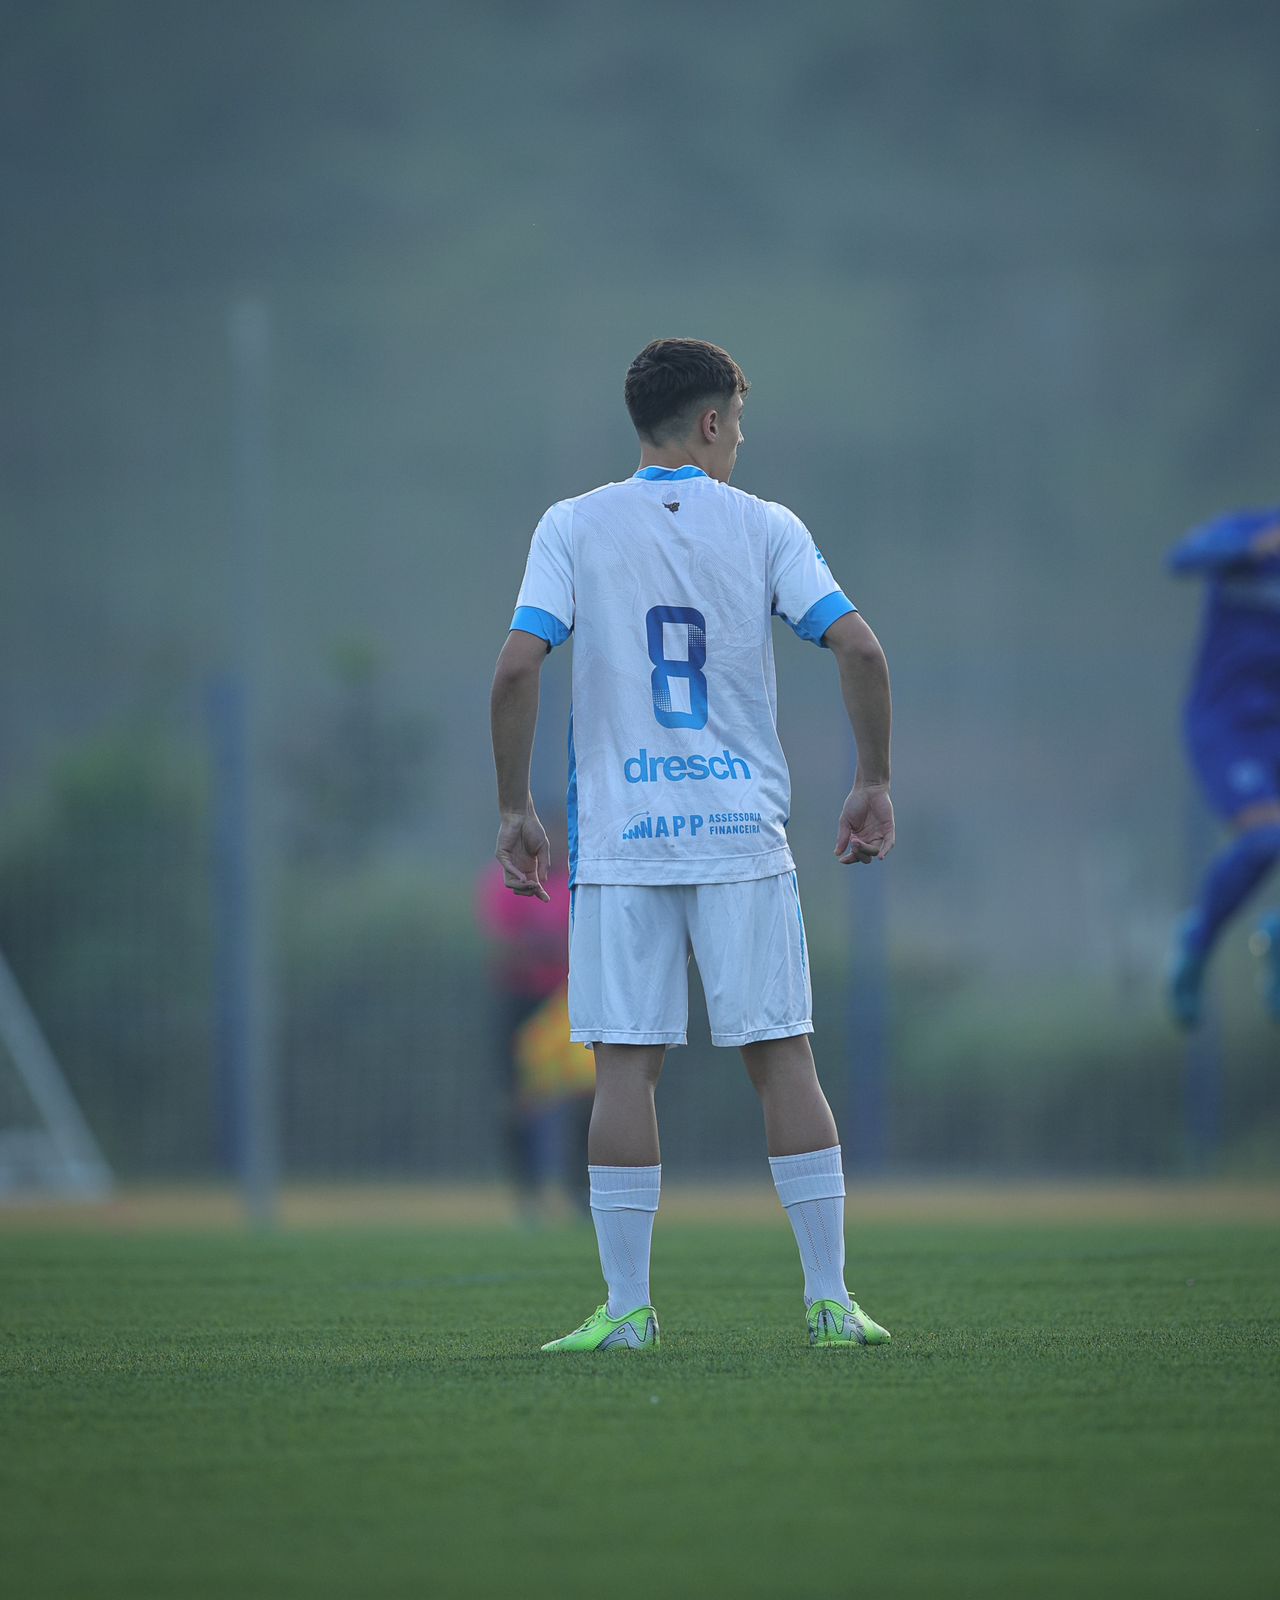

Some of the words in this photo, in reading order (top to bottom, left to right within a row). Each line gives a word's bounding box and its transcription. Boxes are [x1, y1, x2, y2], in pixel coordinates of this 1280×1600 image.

[645, 605, 708, 730] 8
[623, 748, 752, 784] dresch
[708, 812, 762, 824] ASSESSORIA
[709, 824, 761, 835] FINANCEIRA
